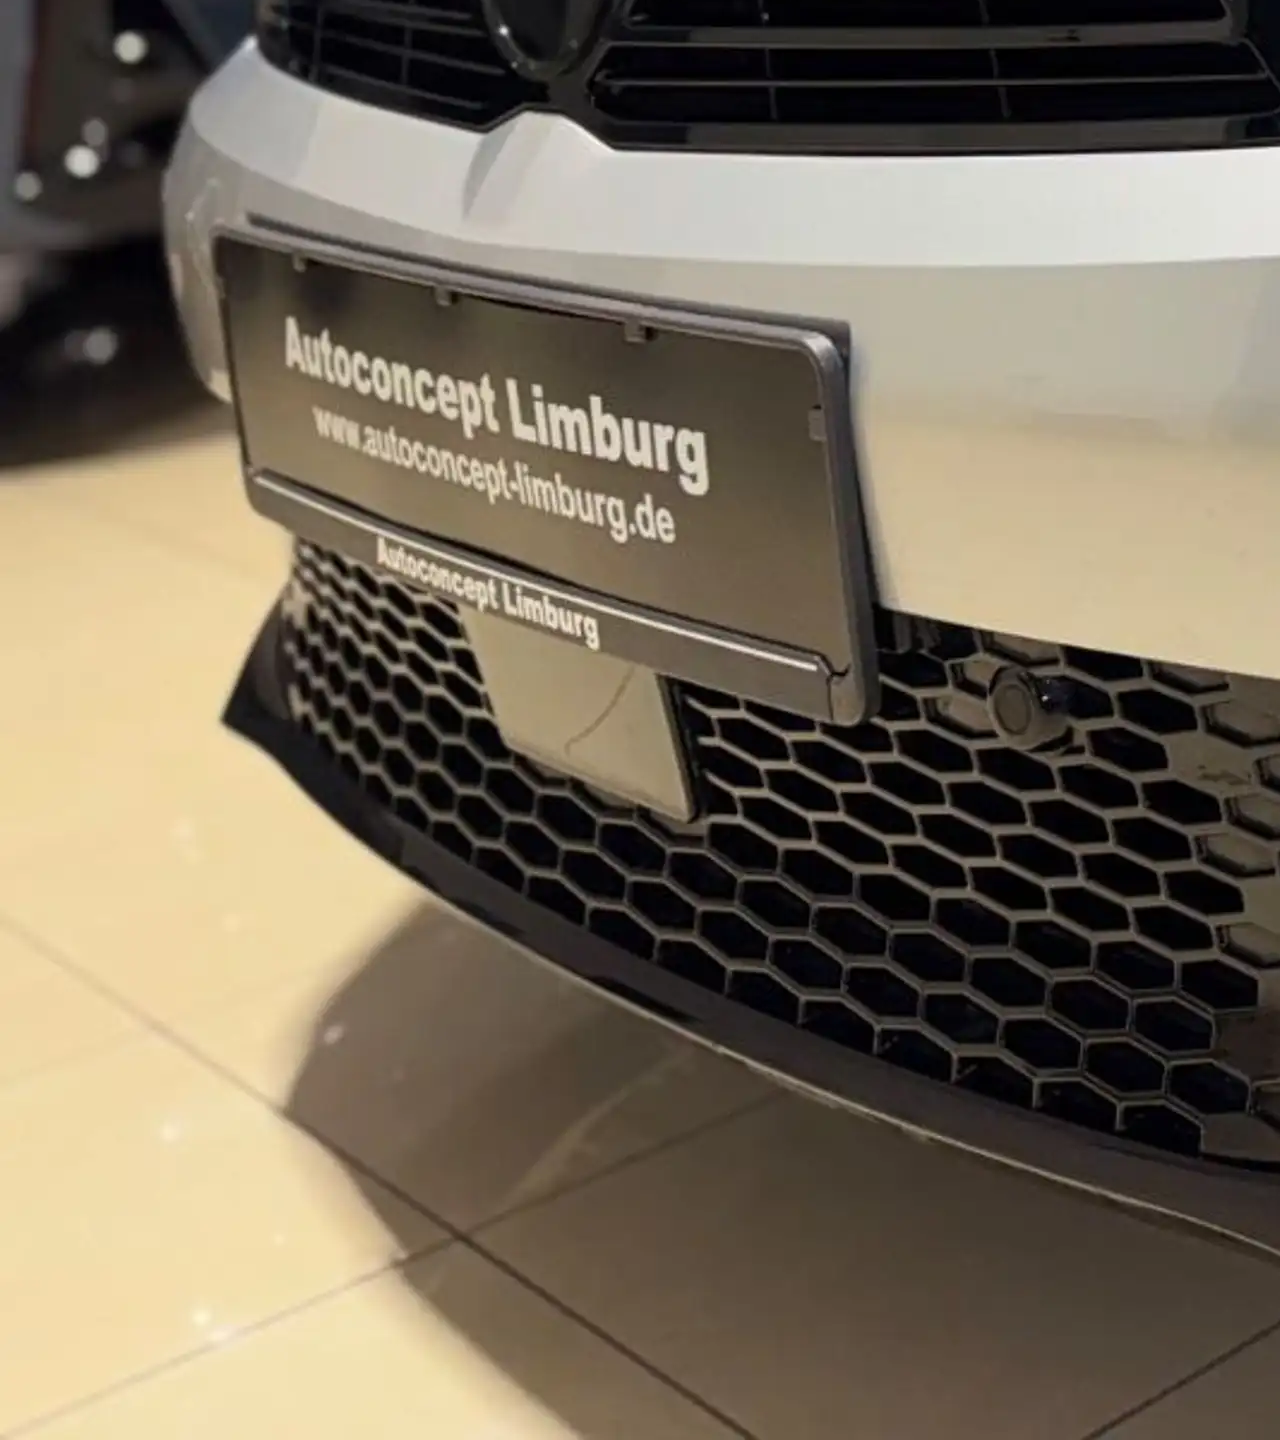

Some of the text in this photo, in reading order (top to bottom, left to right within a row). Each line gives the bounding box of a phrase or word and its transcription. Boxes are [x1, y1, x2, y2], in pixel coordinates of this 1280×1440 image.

[284, 315, 710, 497] Autoconcept Limburg
[311, 405, 677, 543] www.autoconcept-limburg.de
[377, 536, 601, 652] Autoconcept Limburg
